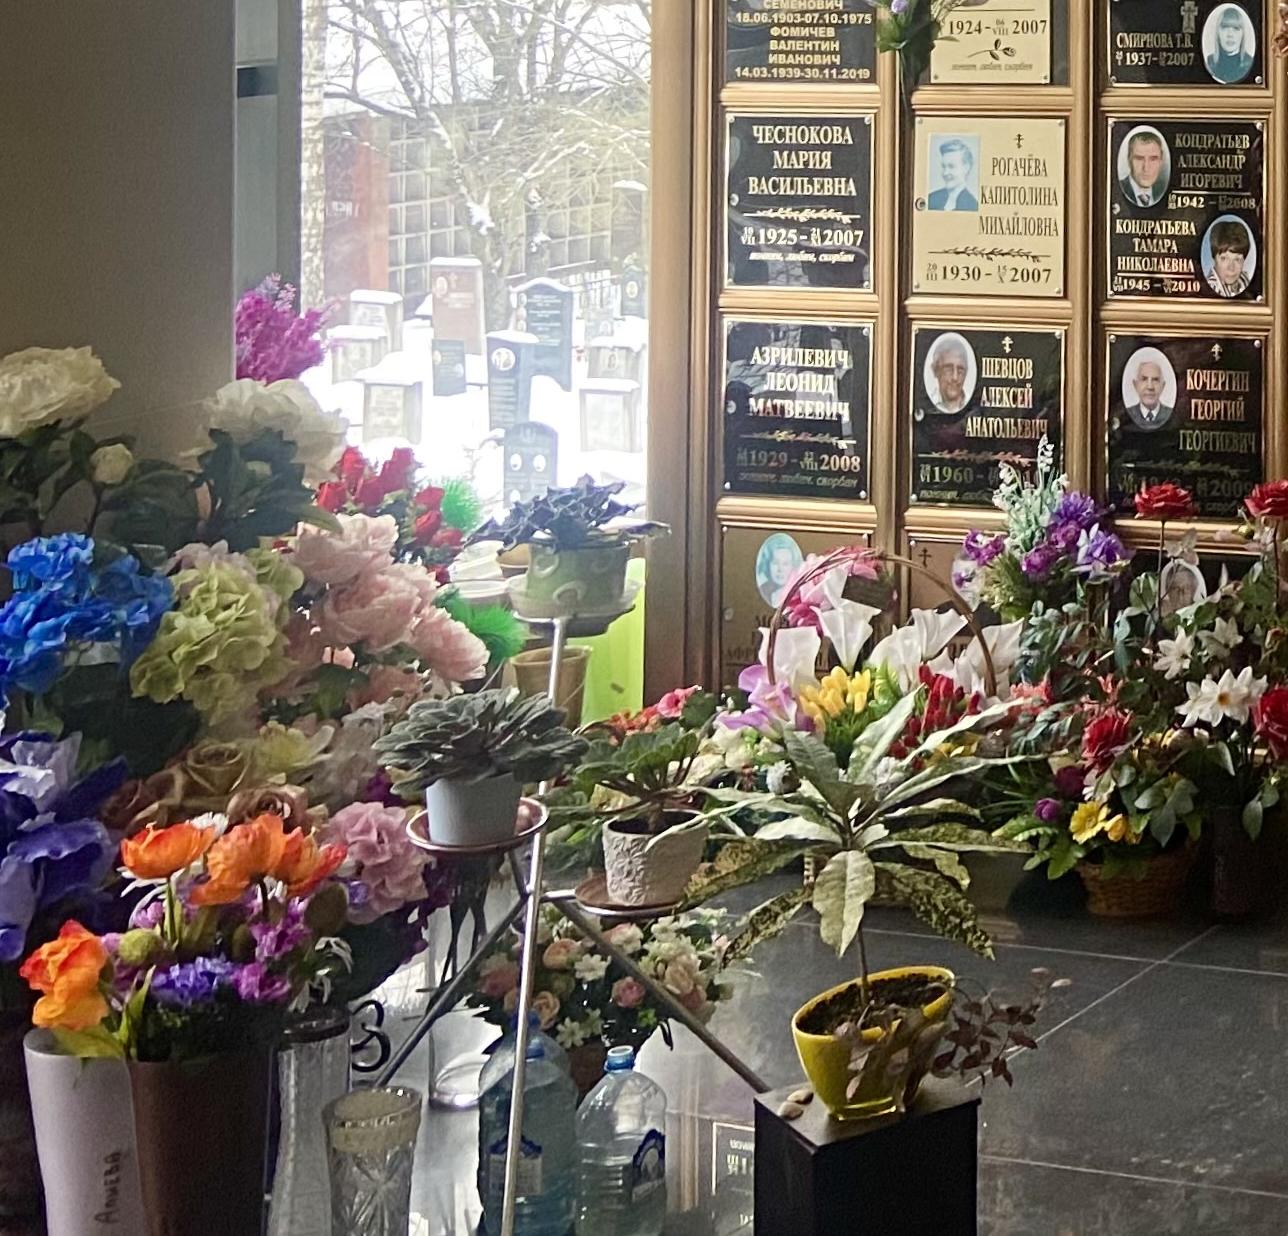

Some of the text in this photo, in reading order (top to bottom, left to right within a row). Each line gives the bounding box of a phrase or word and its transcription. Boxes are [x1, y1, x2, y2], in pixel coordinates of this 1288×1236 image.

[763, 0, 843, 10] СЕМЕНОВИЧ
[770, 27, 835, 38] ФОМИЧЕВ
[949, 19, 1047, 35] 1924 2007
[769, 41, 840, 51] ВАЛЕНТИН
[1117, 33, 1173, 49] СМИРНОВА
[768, 54, 840, 65] ИВАНОВИЧ
[1124, 52, 1194, 66] 1937 2007
[753, 126, 852, 144] ЧЕСНОКОВА
[1175, 132, 1250, 151] КОНДРАТЬЕВ
[773, 151, 832, 169] МАРИЯ
[992, 155, 1048, 177] РОГАЧЁВА
[1178, 154, 1246, 170] АЛЕКСАНДР
[748, 176, 857, 196] ВАСИЛЬЕВНА
[1181, 173, 1242, 189] ИГОРЕВИЧ
[981, 186, 1058, 206] КАПИТОЛИНА
[1177, 195, 1205, 209] 1942
[979, 212, 1059, 236] МИХАЙЛОВНА
[1116, 219, 1196, 238] КОНДРАТЬЕВА
[759, 229, 863, 246] 1925 2007
[1133, 238, 1178, 254] ТАМАРА
[1117, 256, 1195, 273] НИКОЛАЕВНА
[942, 265, 1051, 283] 1930 2007
[1123, 278, 1200, 293] 1945 2010
[750, 348, 850, 370] АЗРИЛЕВИЧ
[982, 358, 1033, 381] ШЕВЦОВ
[764, 373, 836, 395] ЛЕОНИД
[1186, 369, 1249, 391] КОЧЕРГИН
[980, 383, 1033, 409] АЛЕКСЕЙ
[749, 397, 850, 421] МАТВЕЕВИЧ
[1191, 396, 1245, 421] ГЕОРГИЙ
[965, 418, 1048, 439] АНАТОЛЬЕВИЧ
[1178, 430, 1257, 454] ГЕОРГИЕВИЧ
[820, 454, 861, 472] 2008
[932, 464, 974, 483] 1960
